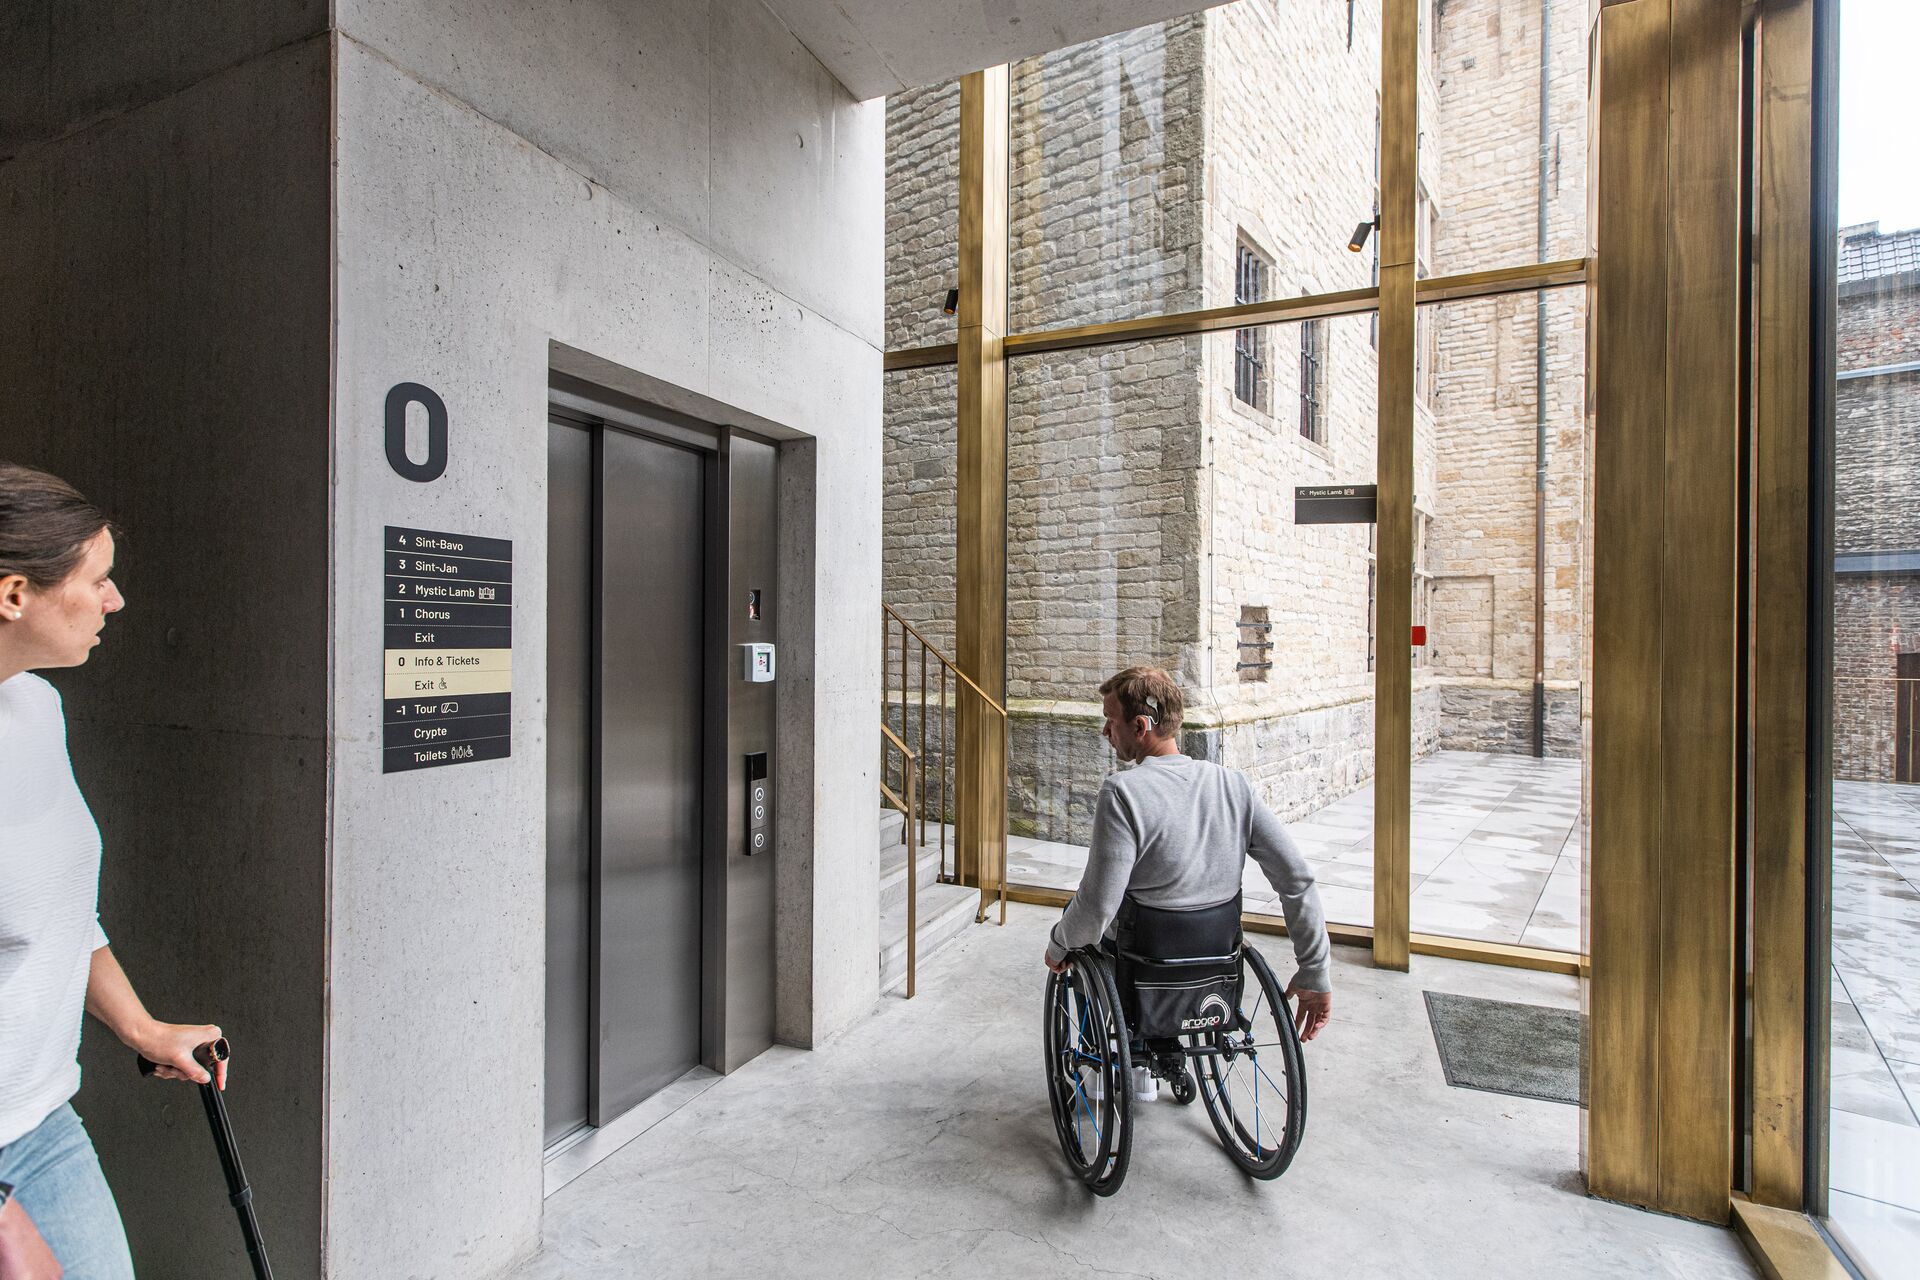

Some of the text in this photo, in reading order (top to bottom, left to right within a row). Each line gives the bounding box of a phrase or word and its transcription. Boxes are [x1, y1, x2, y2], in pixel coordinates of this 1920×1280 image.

[385, 382, 448, 483] 0
[398, 534, 464, 551] 4 Sint-Bavo
[398, 559, 458, 574] 3 Sint-Jan
[398, 583, 476, 598] 2 Mystic Lamb
[399, 608, 451, 620] 1 Chorus
[415, 632, 435, 643] Exit
[398, 656, 480, 667] 0 Info & Tickets
[414, 680, 435, 691] Exit
[396, 704, 437, 716] -1 Tour
[414, 727, 448, 740] Crypte
[414, 751, 448, 763] Toilets
